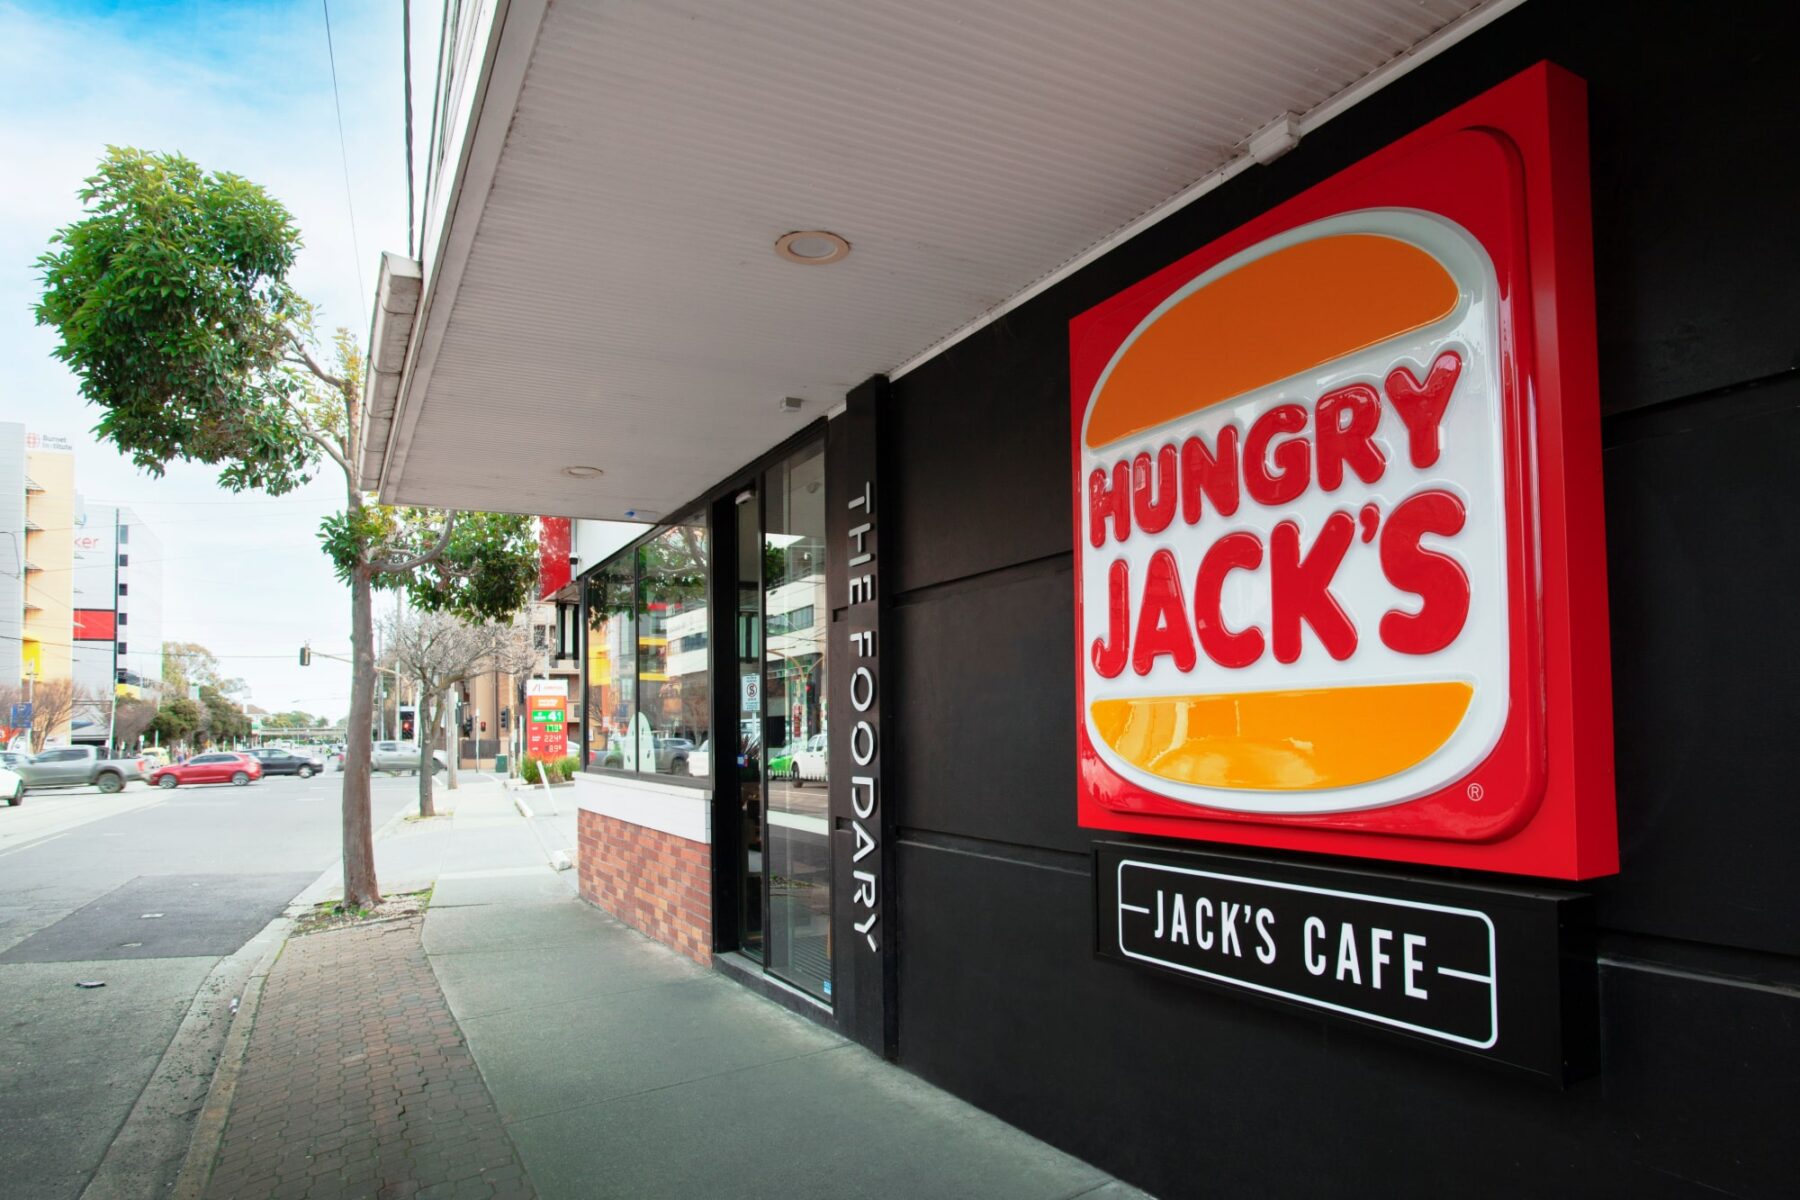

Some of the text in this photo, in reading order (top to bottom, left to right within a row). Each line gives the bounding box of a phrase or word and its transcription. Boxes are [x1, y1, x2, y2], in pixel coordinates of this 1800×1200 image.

[1088, 349, 1462, 549] HUNGRY
[1090, 489, 1470, 679] JACK'S
[848, 481, 877, 952] THE FOODARY
[1154, 889, 1429, 1001] JACK'S CAFE
